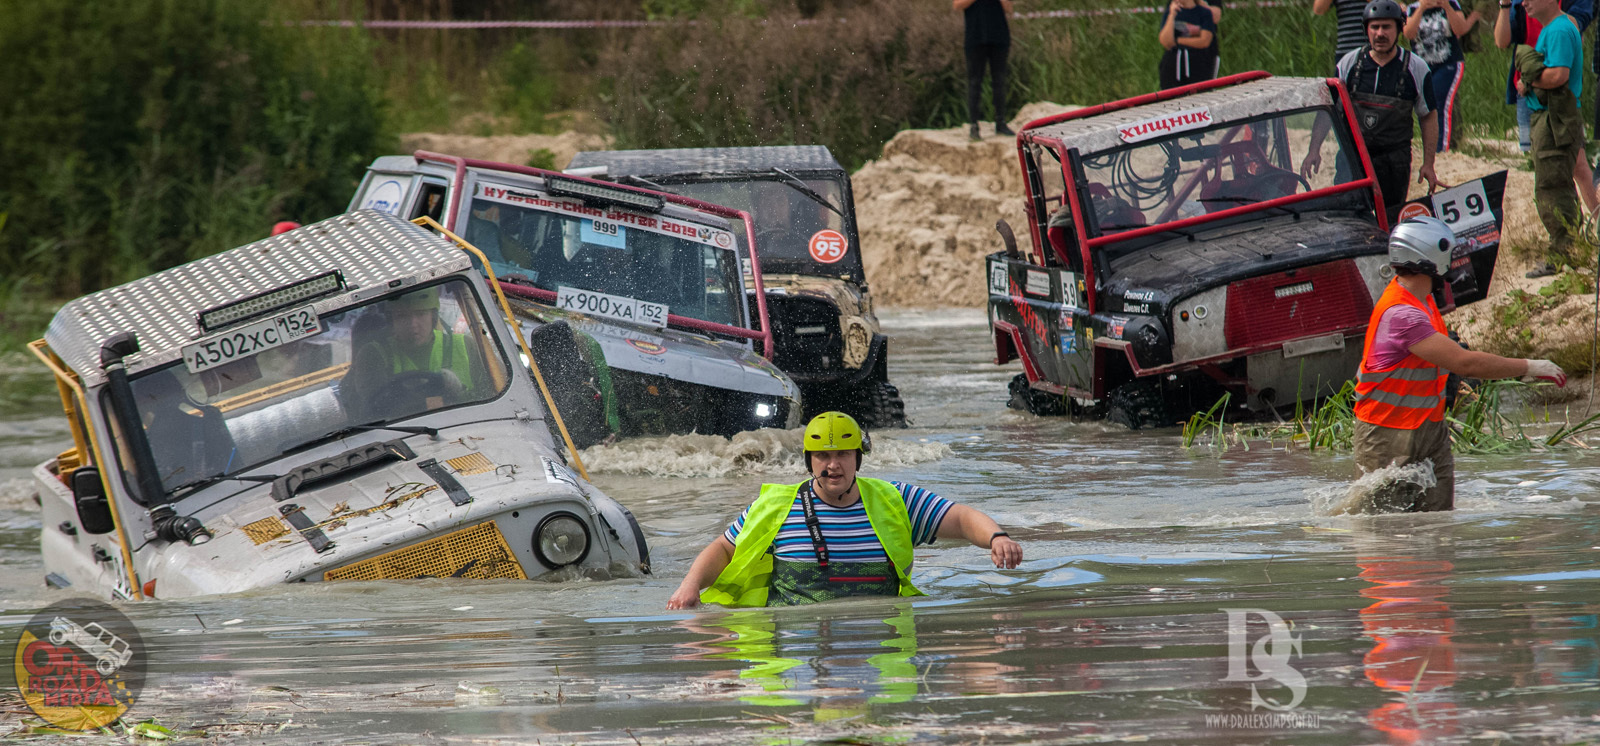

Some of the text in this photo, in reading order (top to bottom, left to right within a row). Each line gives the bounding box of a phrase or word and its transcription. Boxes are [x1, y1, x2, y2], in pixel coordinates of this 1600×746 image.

[1442, 193, 1484, 224] 59
[593, 220, 617, 235] 999
[662, 221, 697, 238] 2019
[815, 240, 841, 257] 95
[1063, 282, 1077, 307] 59
[564, 292, 663, 319] К900ХА 152
[194, 310, 312, 369] А502ХС 152
[289, 330, 306, 339] RUS
